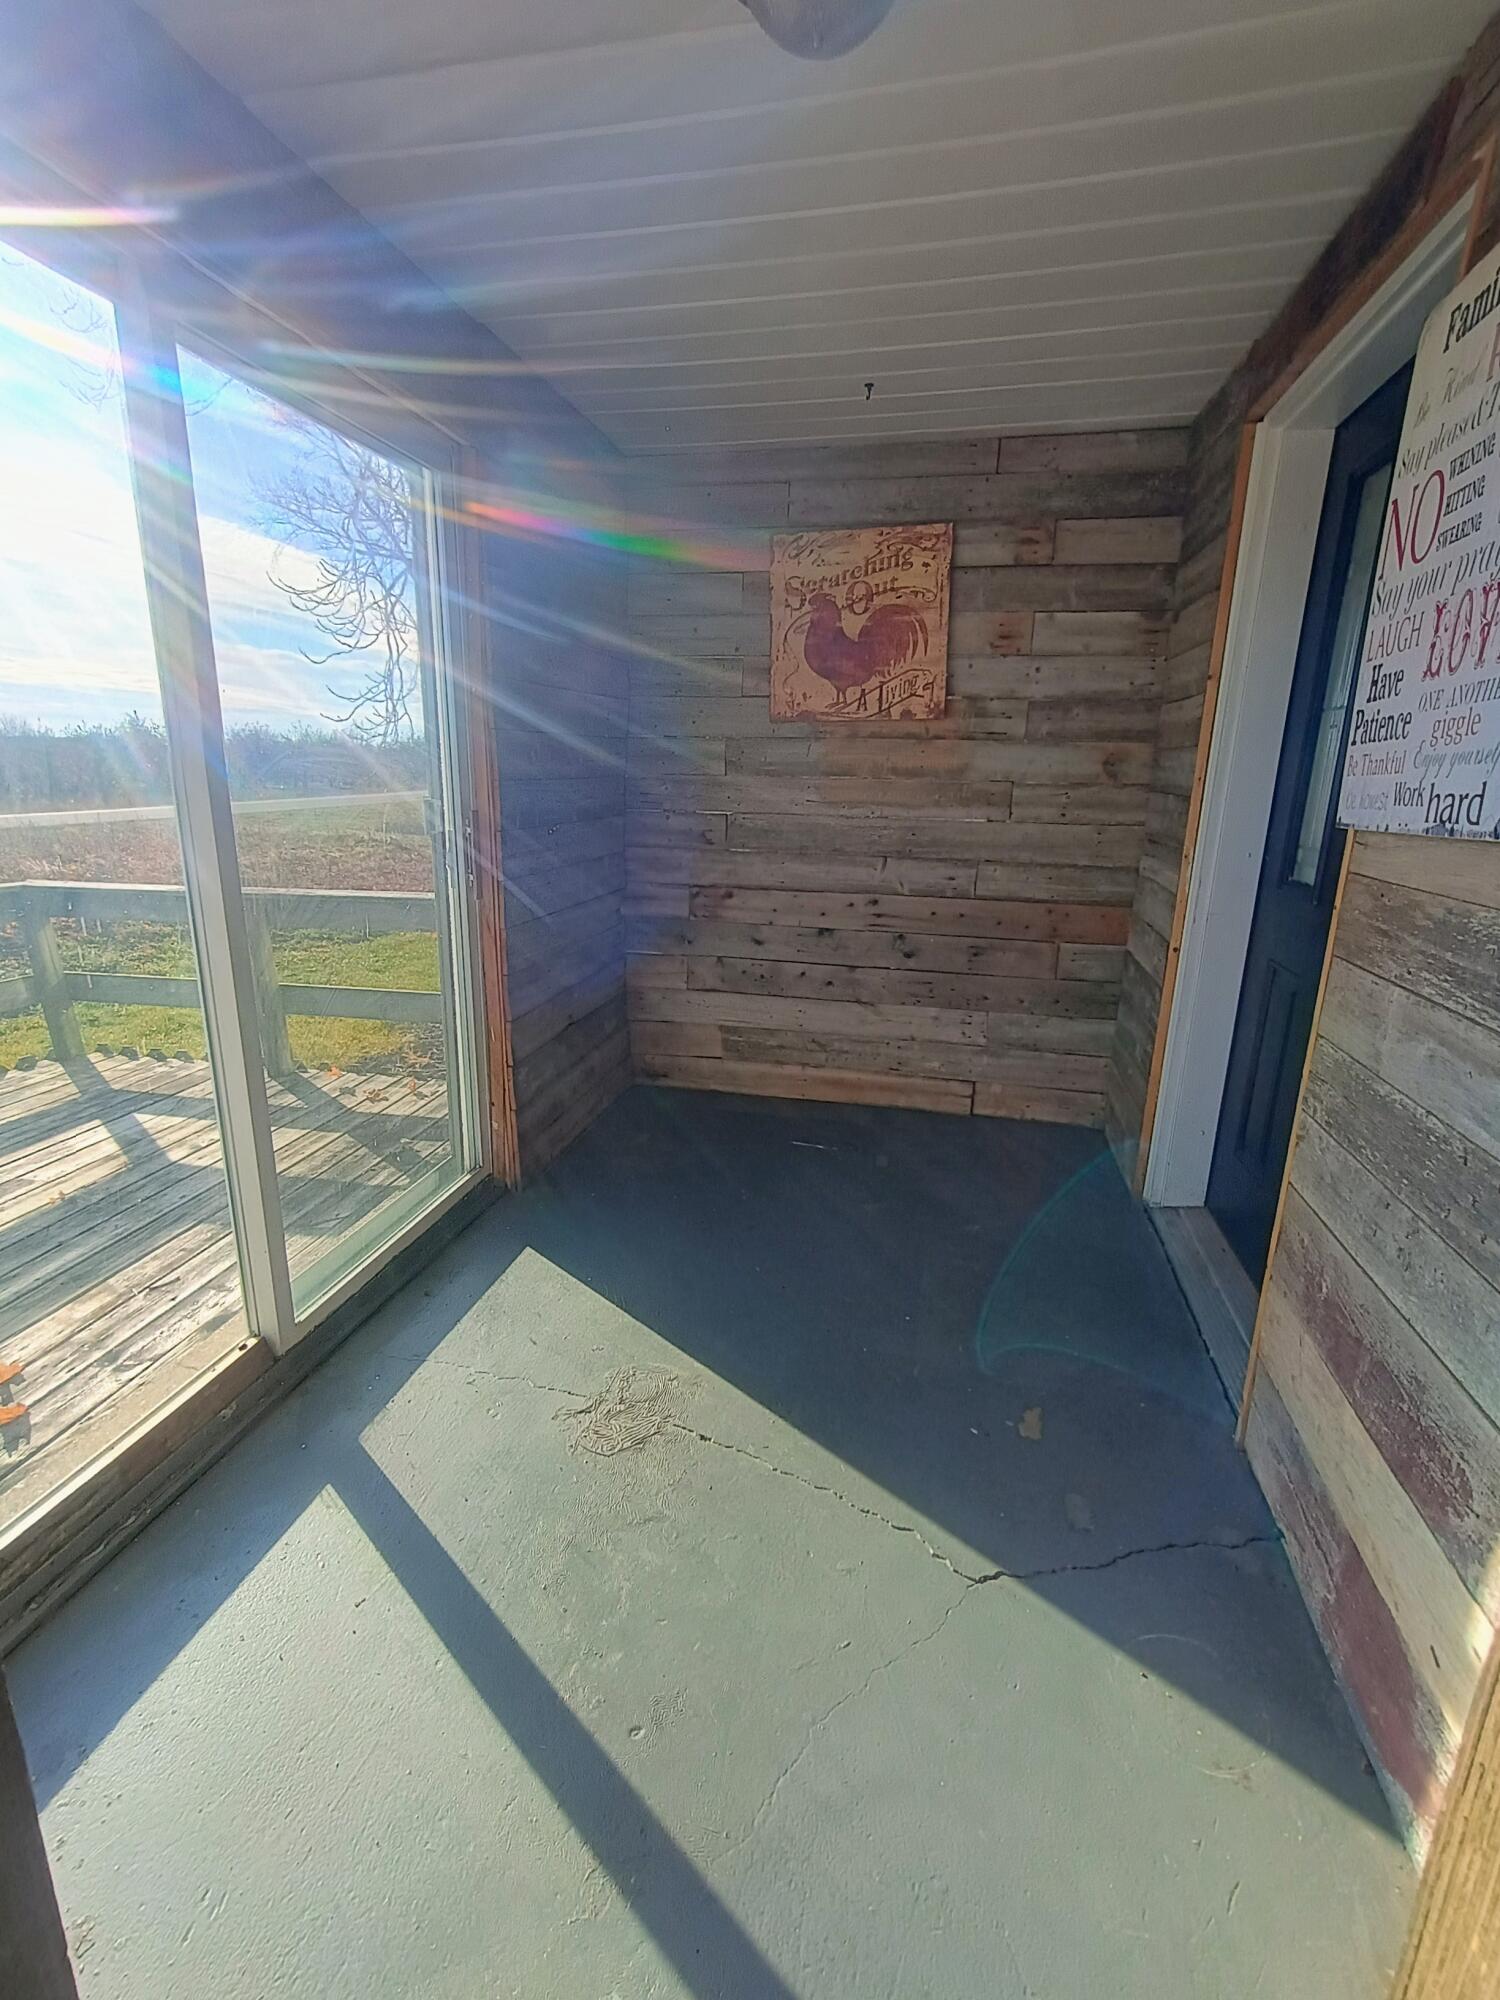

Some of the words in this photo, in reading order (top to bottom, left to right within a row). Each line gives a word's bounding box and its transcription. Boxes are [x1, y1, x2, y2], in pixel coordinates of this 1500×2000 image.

[1443, 266, 1500, 354] Fami
[1398, 447, 1425, 479] Say
[1449, 432, 1496, 481] WHINING
[1443, 475, 1485, 517] HITTING
[1378, 469, 1445, 580] NO
[1436, 512, 1482, 552] SWEARING
[784, 547, 914, 611] Scratching
[846, 576, 899, 615] Out
[1371, 580, 1404, 620] Say
[1404, 561, 1453, 615] your
[1366, 611, 1425, 662] LAUGH
[1421, 580, 1500, 682] LOV
[856, 688, 868, 712] A
[878, 674, 920, 713] Living
[1366, 663, 1404, 703] Have
[1418, 689, 1444, 712] ONE
[1350, 709, 1412, 747] Patience
[1430, 707, 1481, 747] giggle
[1347, 754, 1359, 777] Be
[1361, 750, 1407, 776] Thankful
[1413, 740, 1447, 784] Enjoy
[1393, 781, 1426, 808] Work
[1424, 780, 1487, 826] hard
